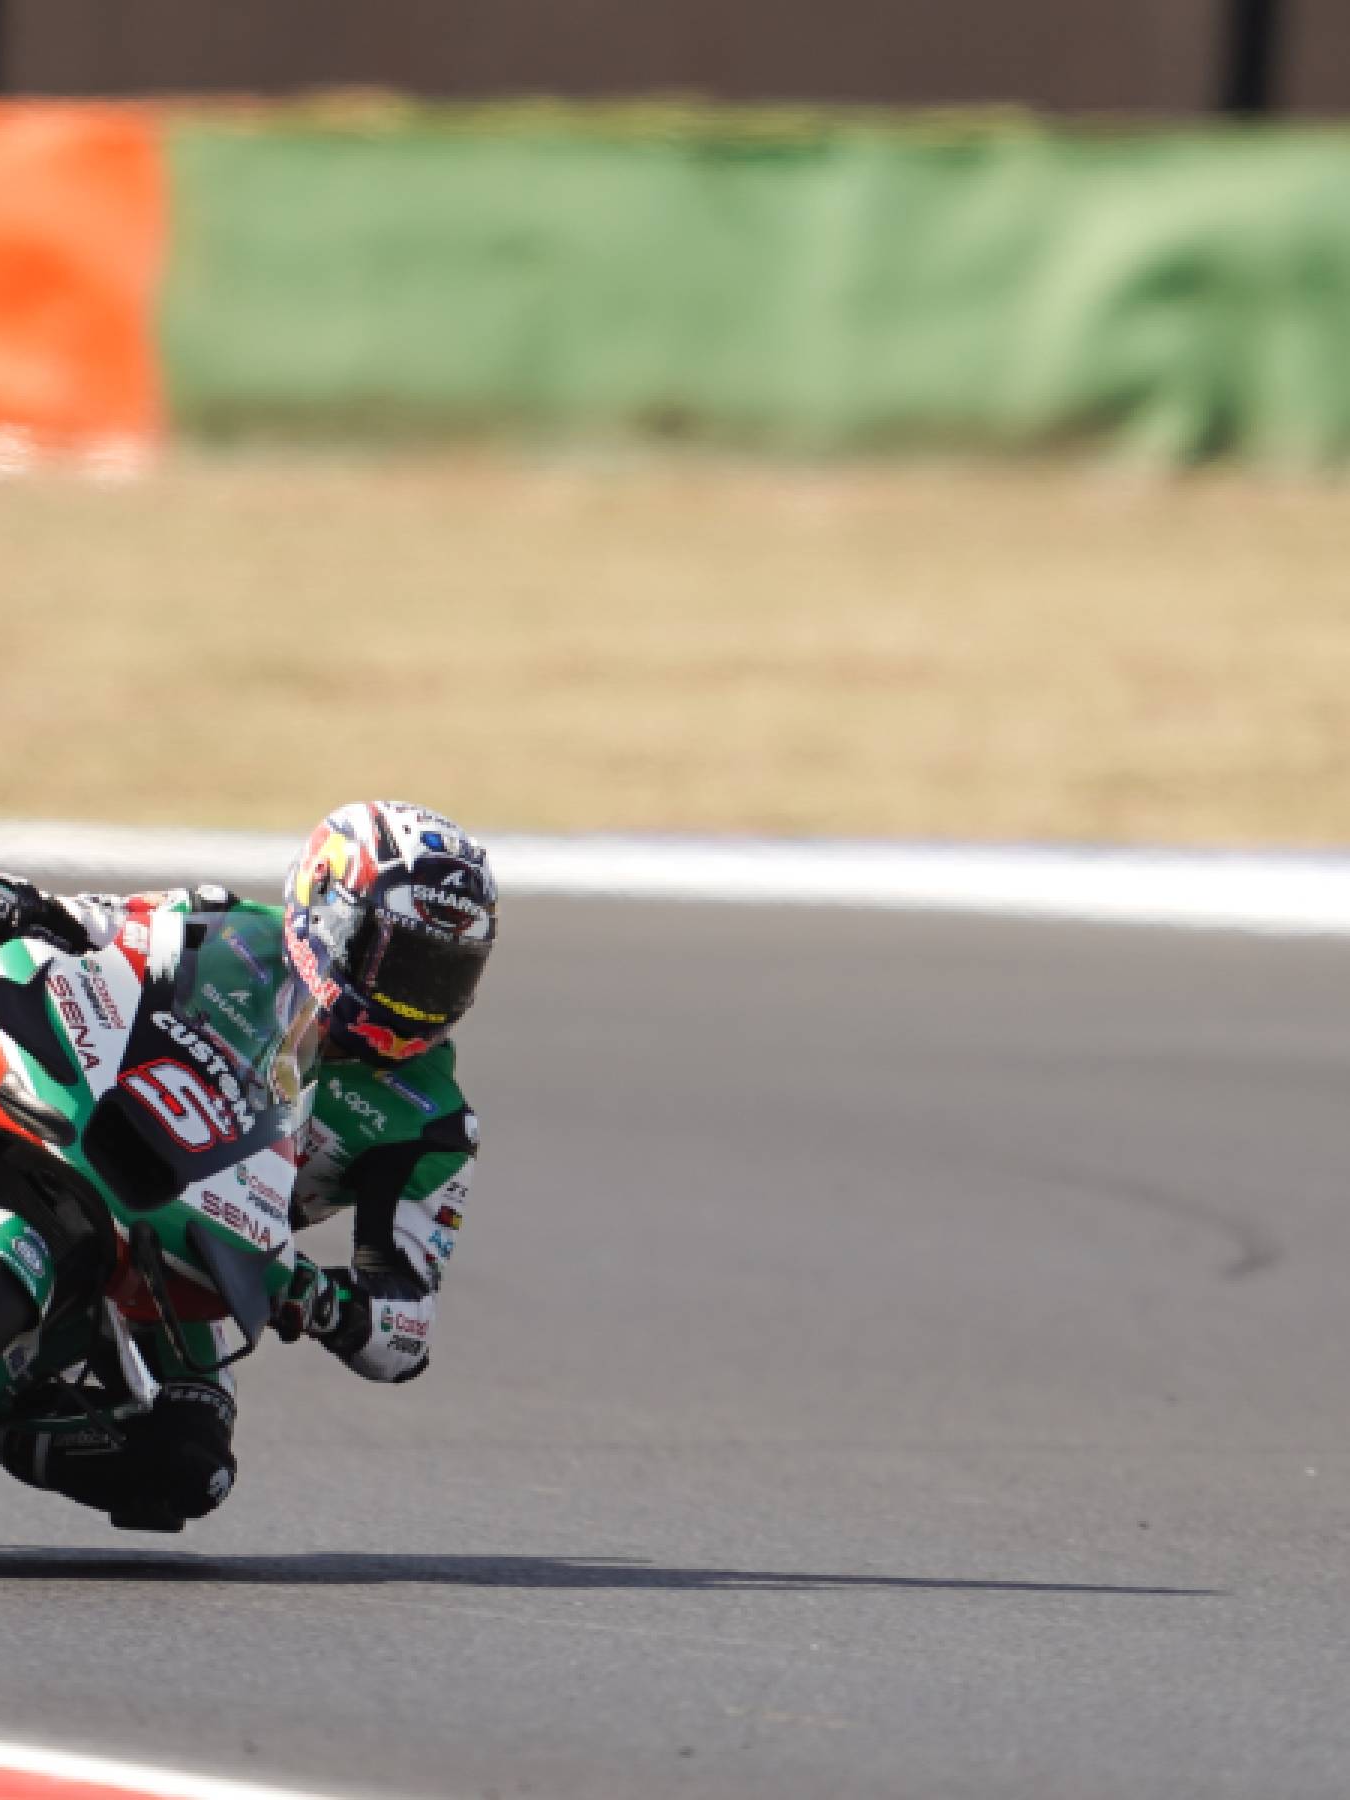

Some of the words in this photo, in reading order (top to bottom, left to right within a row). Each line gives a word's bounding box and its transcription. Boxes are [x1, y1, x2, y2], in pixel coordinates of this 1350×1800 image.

[46, 974, 101, 1072] SENA
[118, 1056, 238, 1152] 5
[152, 1011, 256, 1134] CUSTOM
[201, 1189, 272, 1252] SENA
